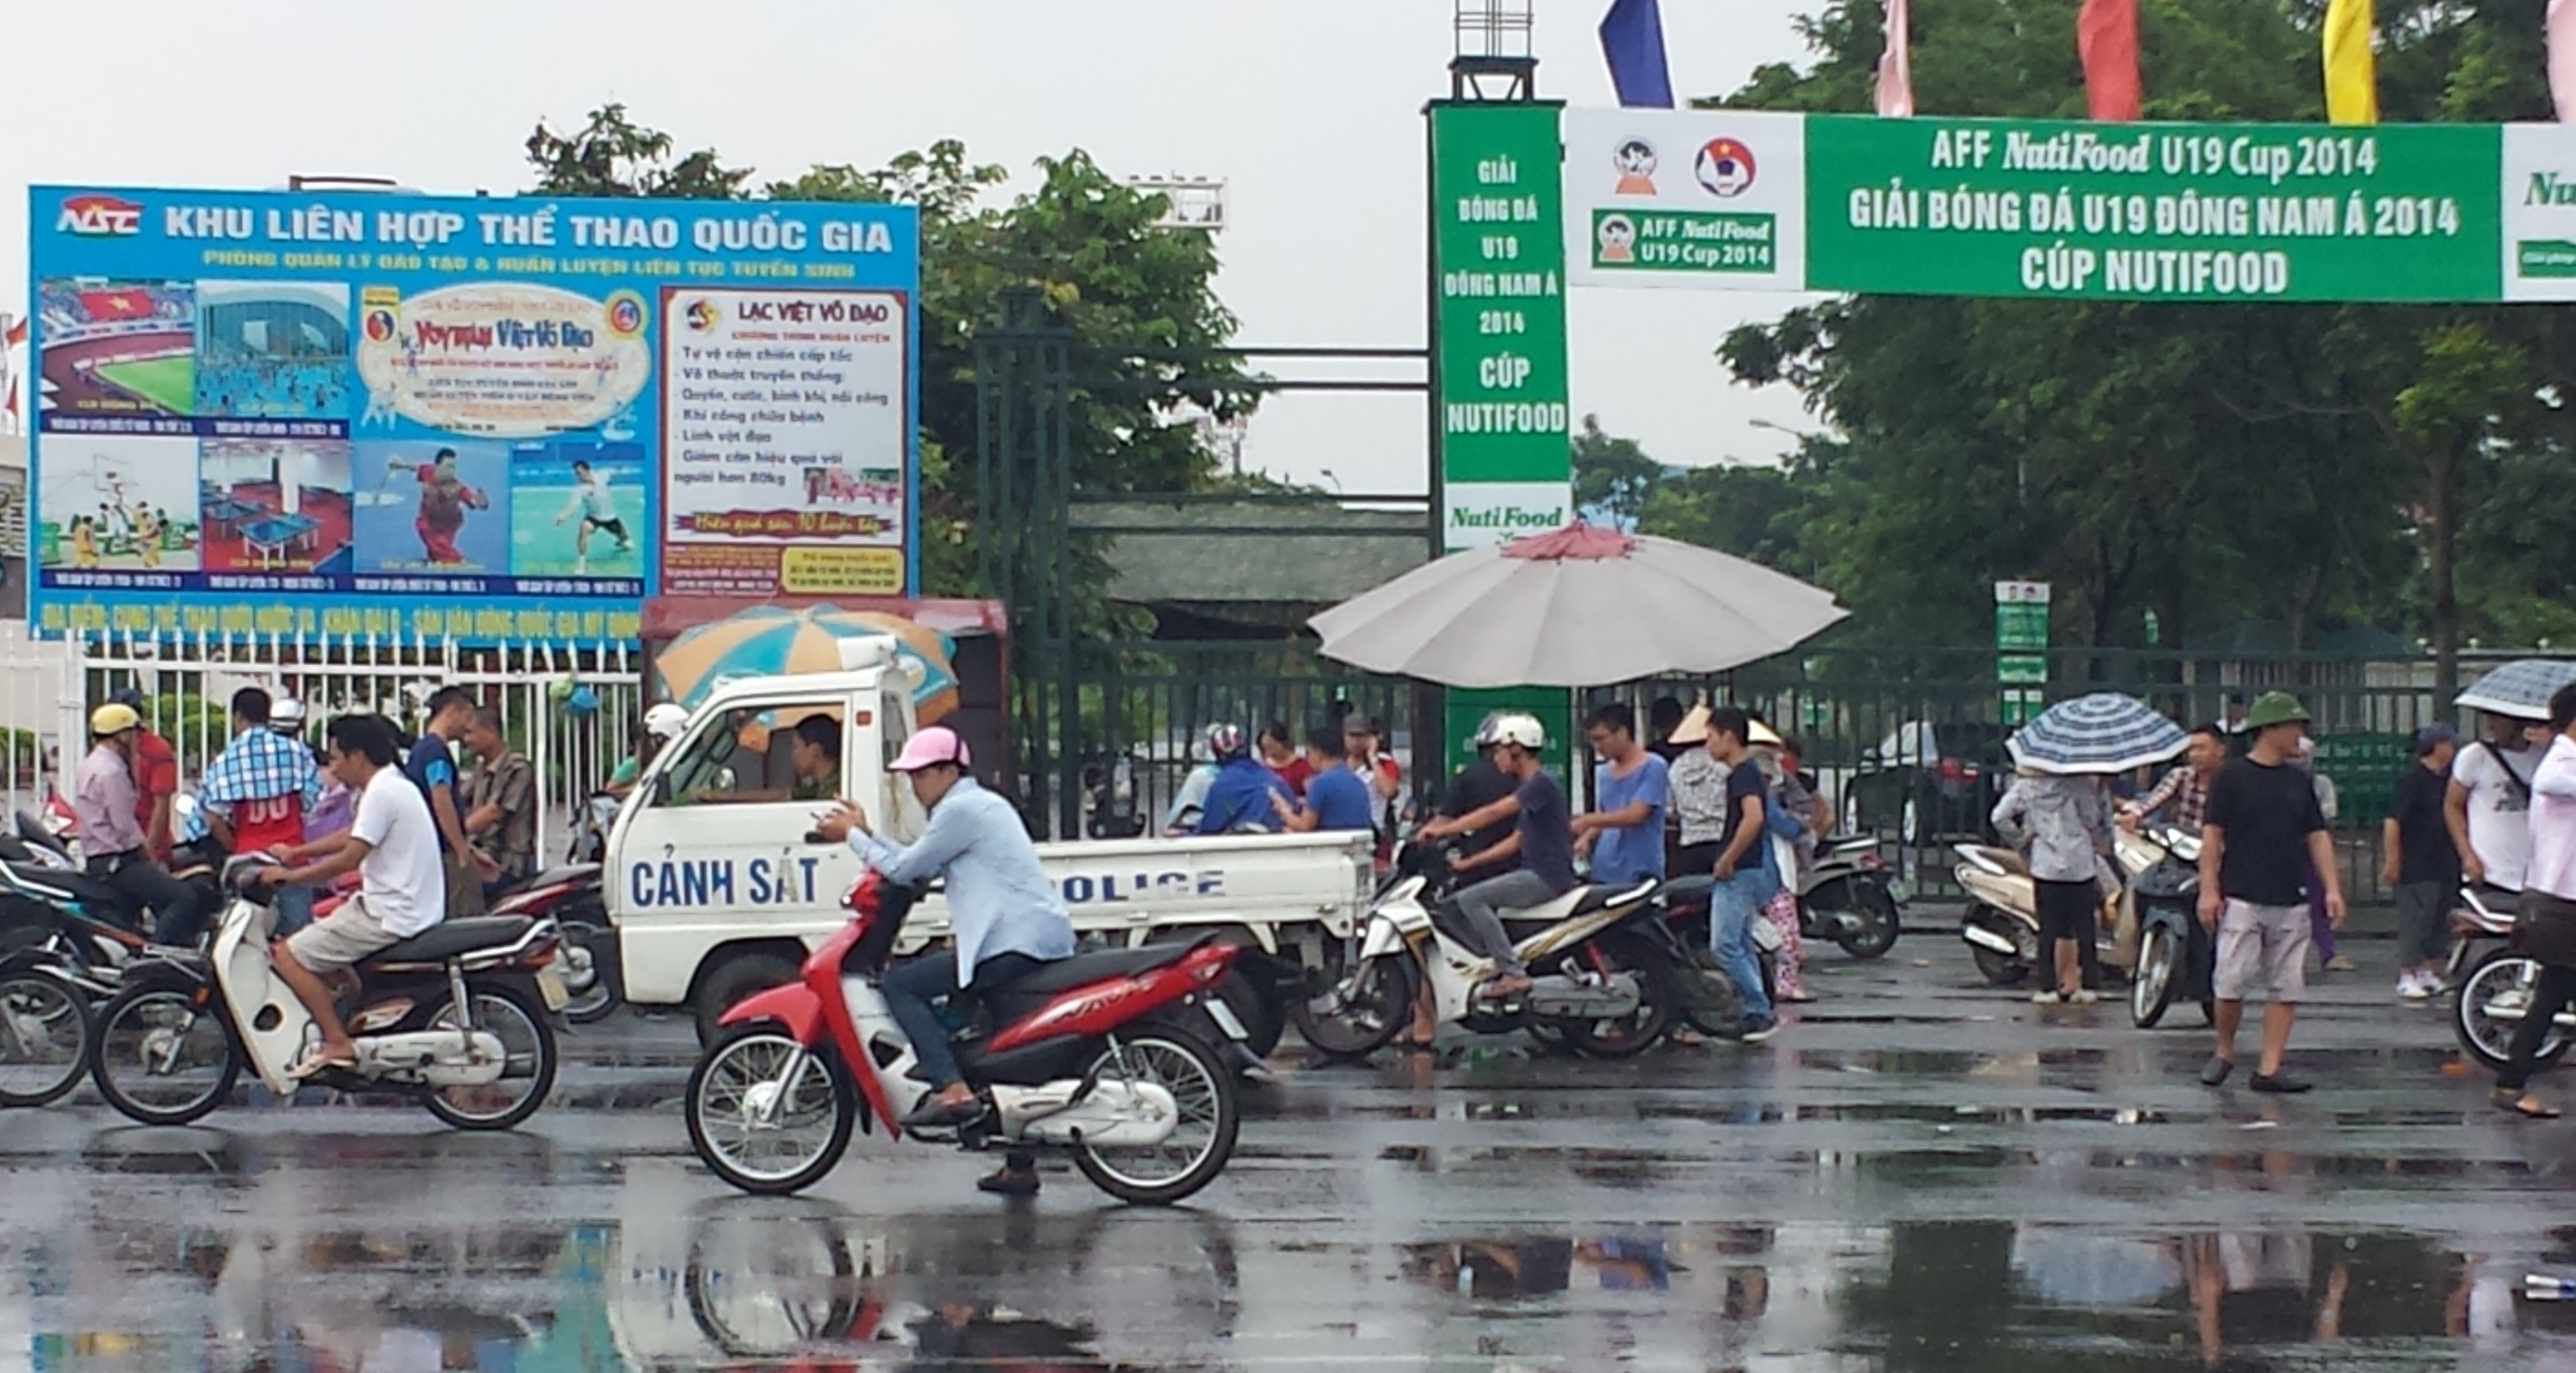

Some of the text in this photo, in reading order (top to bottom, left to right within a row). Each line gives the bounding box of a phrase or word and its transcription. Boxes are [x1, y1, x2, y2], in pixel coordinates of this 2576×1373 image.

[1477, 154, 1518, 184] GIẢI
[1930, 130, 2378, 186] AFF NutiFood U19 Cup 2014
[1458, 194, 1509, 222] BÓNG
[1849, 176, 2460, 237] GIẢI BÓNG ĐÁ U19 ĐÔNG NAM Á 2014
[164, 202, 893, 253] KHU LIÊN HỢP THỂ THAO QUỐC GIA
[1641, 219, 1770, 241] AFF NutiFood
[1481, 236, 1518, 260] U19
[1641, 244, 1770, 268] U19 Cup 2014
[2021, 240, 2289, 294] CÚP NUTIFOOD
[1444, 268, 1558, 296] ĐÔNG NAM Á
[739, 302, 773, 323] LẠC
[777, 299, 815, 324] VIỆT
[1479, 311, 1525, 334] 2014
[1480, 351, 1530, 388] CÚP
[1447, 403, 1565, 434] NUTIFOOD
[1450, 507, 1562, 528] NutiFood
[632, 844, 819, 907] CẢNH SÁT
